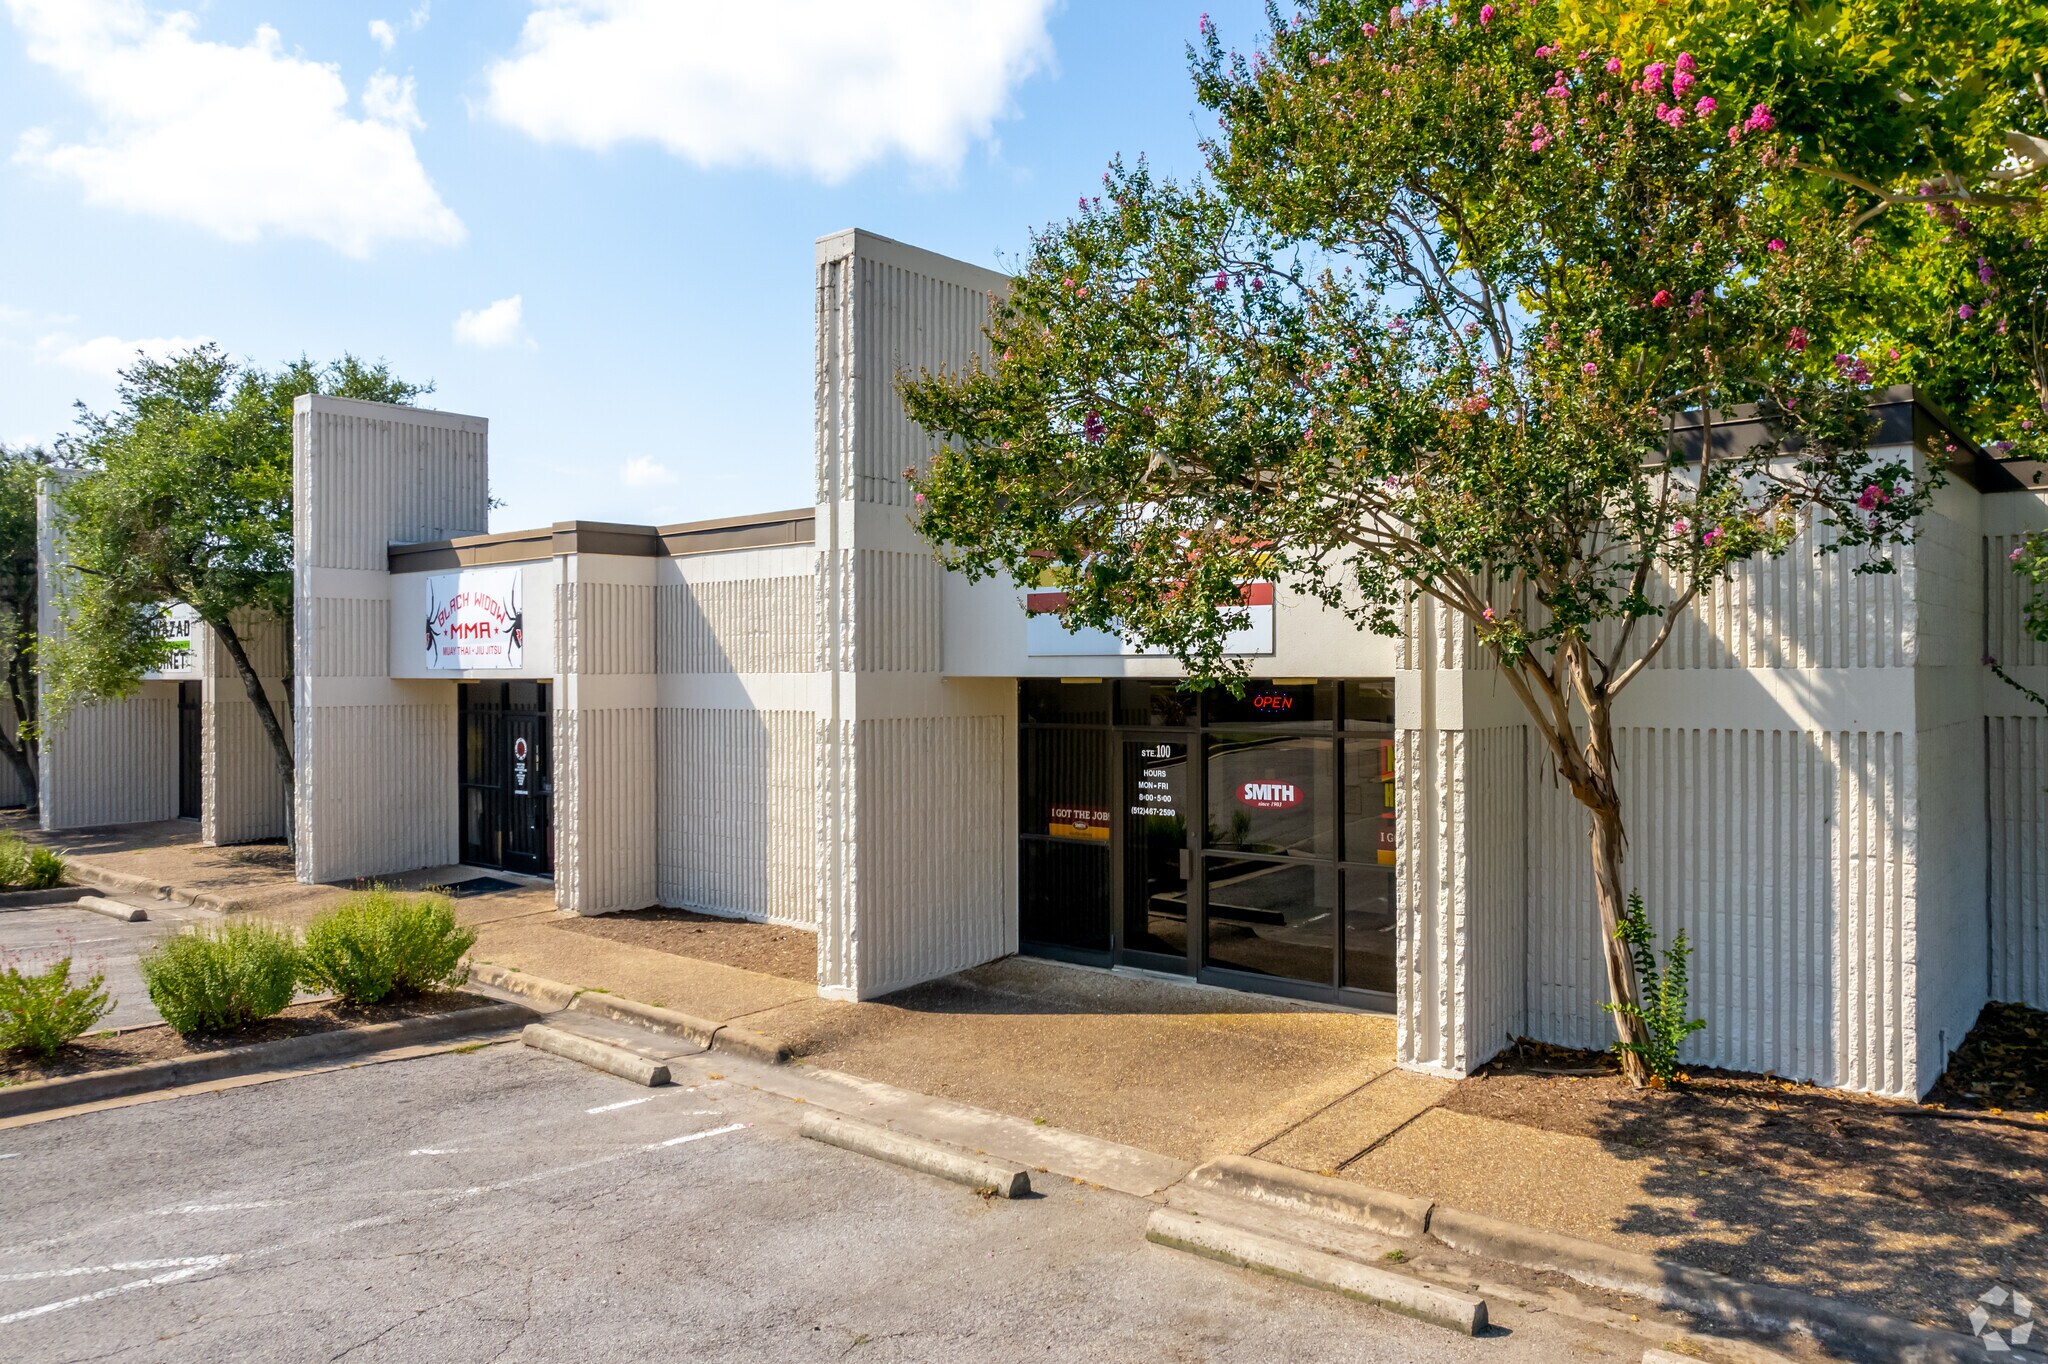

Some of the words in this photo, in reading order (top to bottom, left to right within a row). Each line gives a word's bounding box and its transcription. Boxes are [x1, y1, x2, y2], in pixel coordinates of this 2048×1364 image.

[437, 592, 470, 628] BLACK
[474, 592, 507, 626] WIDOW
[450, 621, 491, 641] MMA
[442, 646, 457, 656] MUAY
[457, 646, 471, 656] THAI
[475, 645, 485, 655] JIU
[486, 645, 502, 655] JITSU
[1253, 696, 1293, 709] OPEN
[1143, 769, 1167, 778] HOURS
[1244, 783, 1295, 802] SMITH
[1051, 807, 1055, 817] I
[1055, 808, 1072, 818] GOT
[1073, 809, 1091, 820] THE
